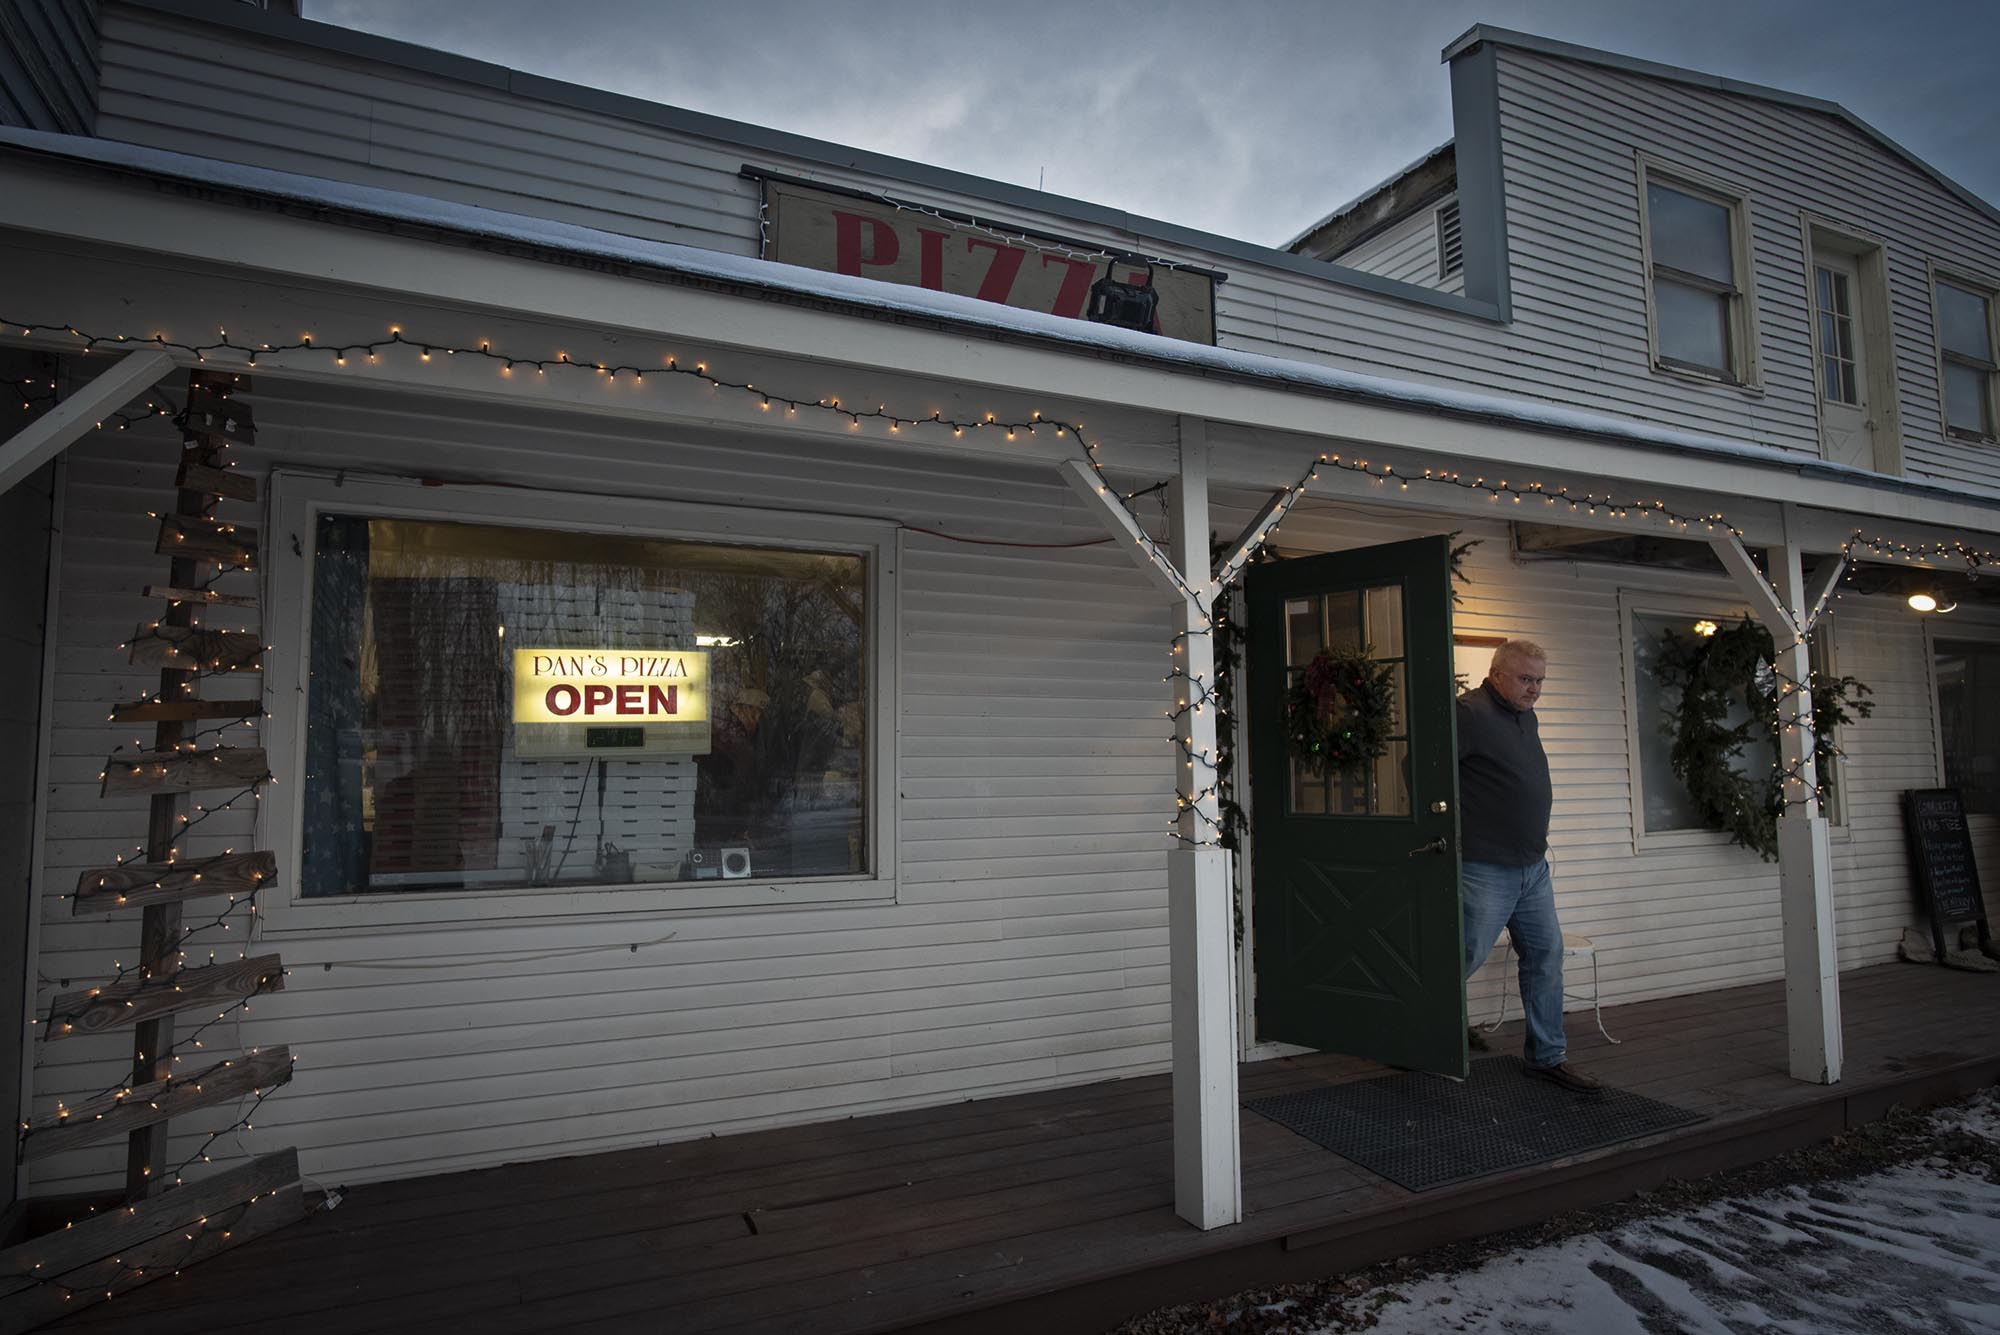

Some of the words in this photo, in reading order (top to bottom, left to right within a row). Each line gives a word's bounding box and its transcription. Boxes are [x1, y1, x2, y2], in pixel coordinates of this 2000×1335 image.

[831, 209, 1163, 336] PIZZ
[533, 654, 608, 677] PAN'S
[620, 656, 688, 678] PIZZA
[545, 684, 678, 716] OPEN
